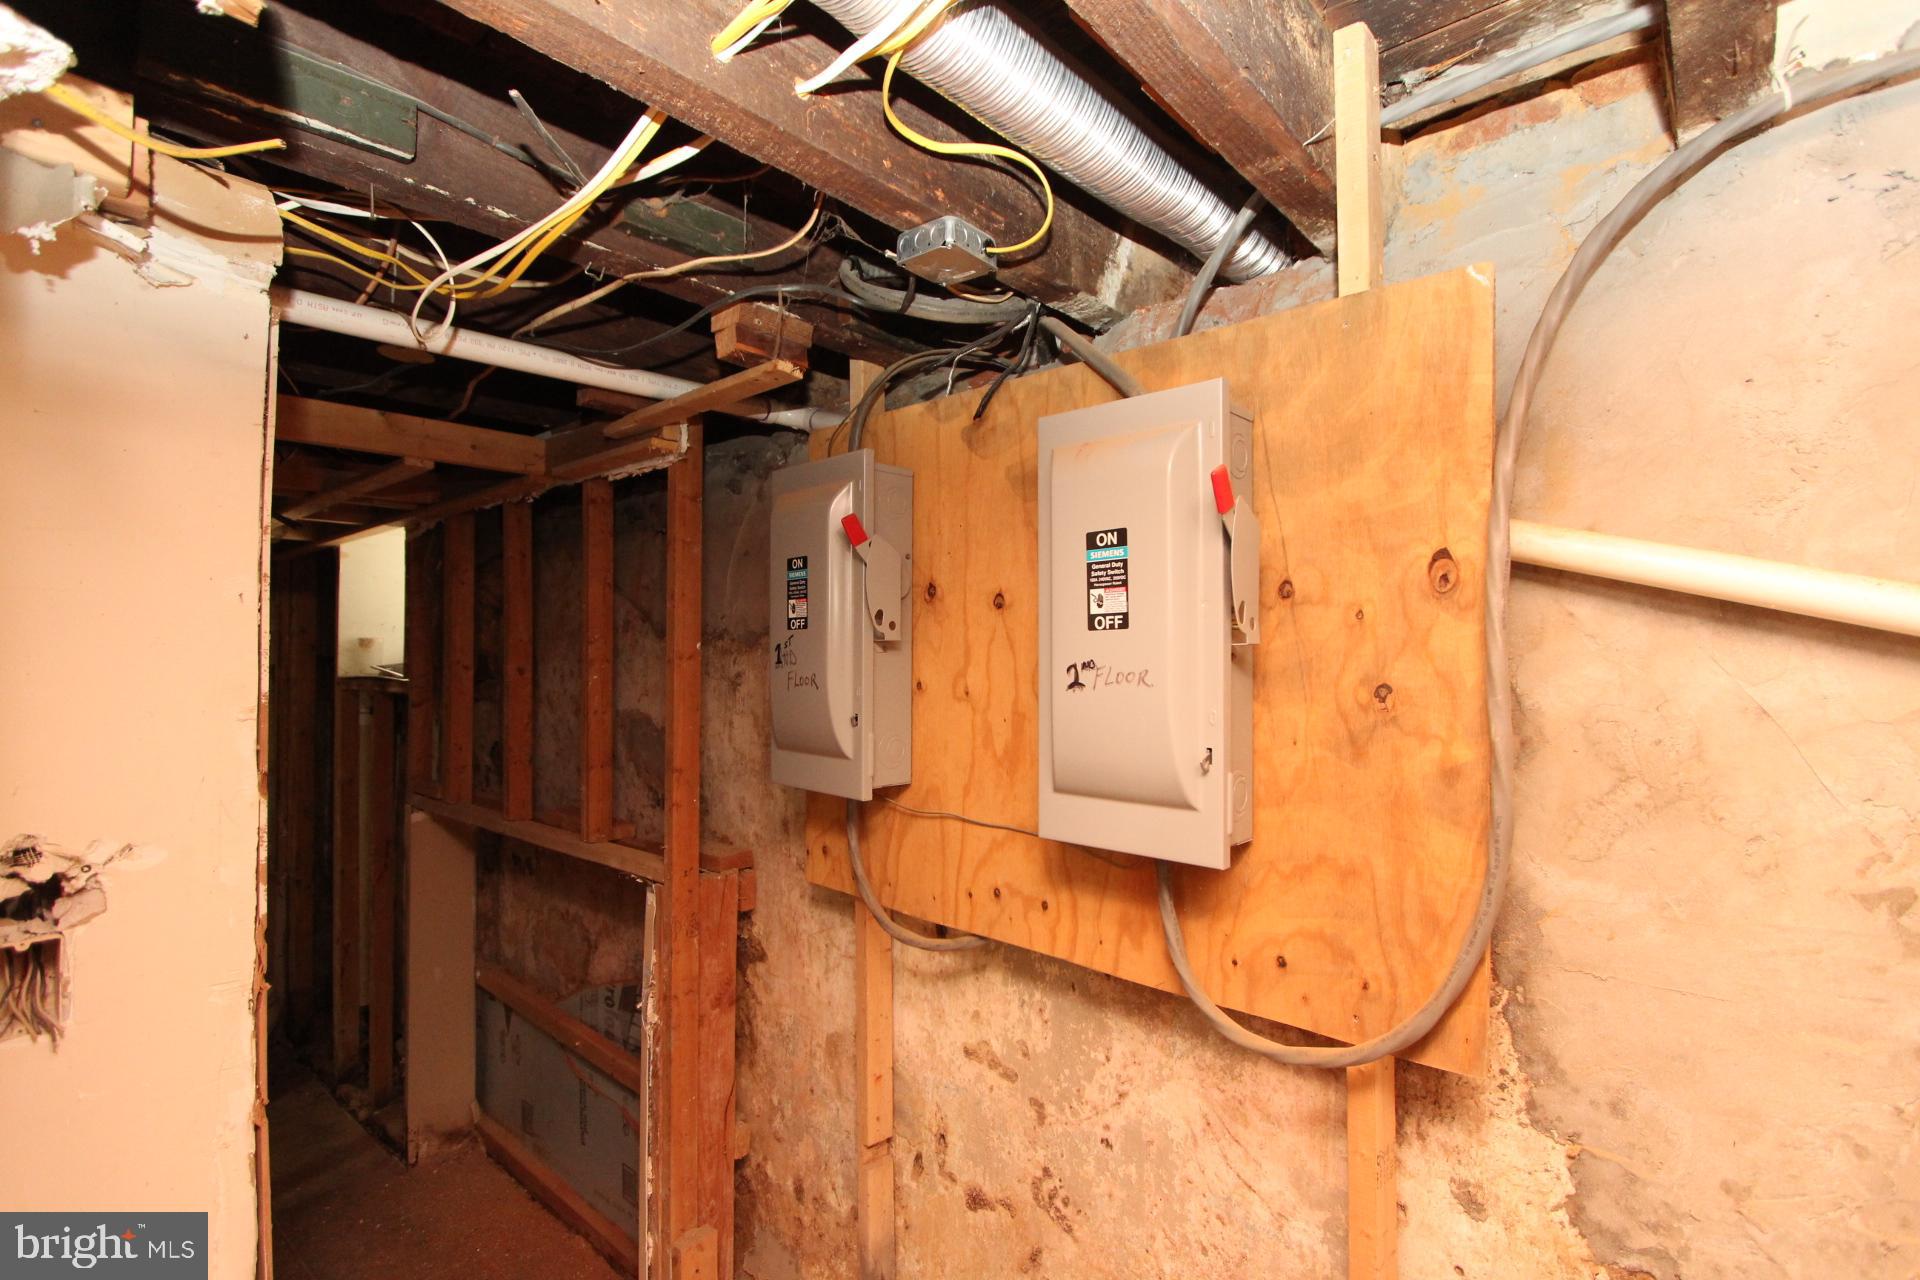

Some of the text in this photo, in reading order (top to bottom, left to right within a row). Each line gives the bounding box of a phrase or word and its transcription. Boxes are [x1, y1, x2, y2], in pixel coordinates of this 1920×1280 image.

[1096, 532, 1118, 547] ON
[1090, 549, 1125, 560] SIEMENS
[791, 560, 803, 569] ON
[790, 619, 806, 630] OFF
[1094, 615, 1124, 630] OFF
[786, 671, 820, 691] FLOOR
[1093, 664, 1154, 691] FLOOR
